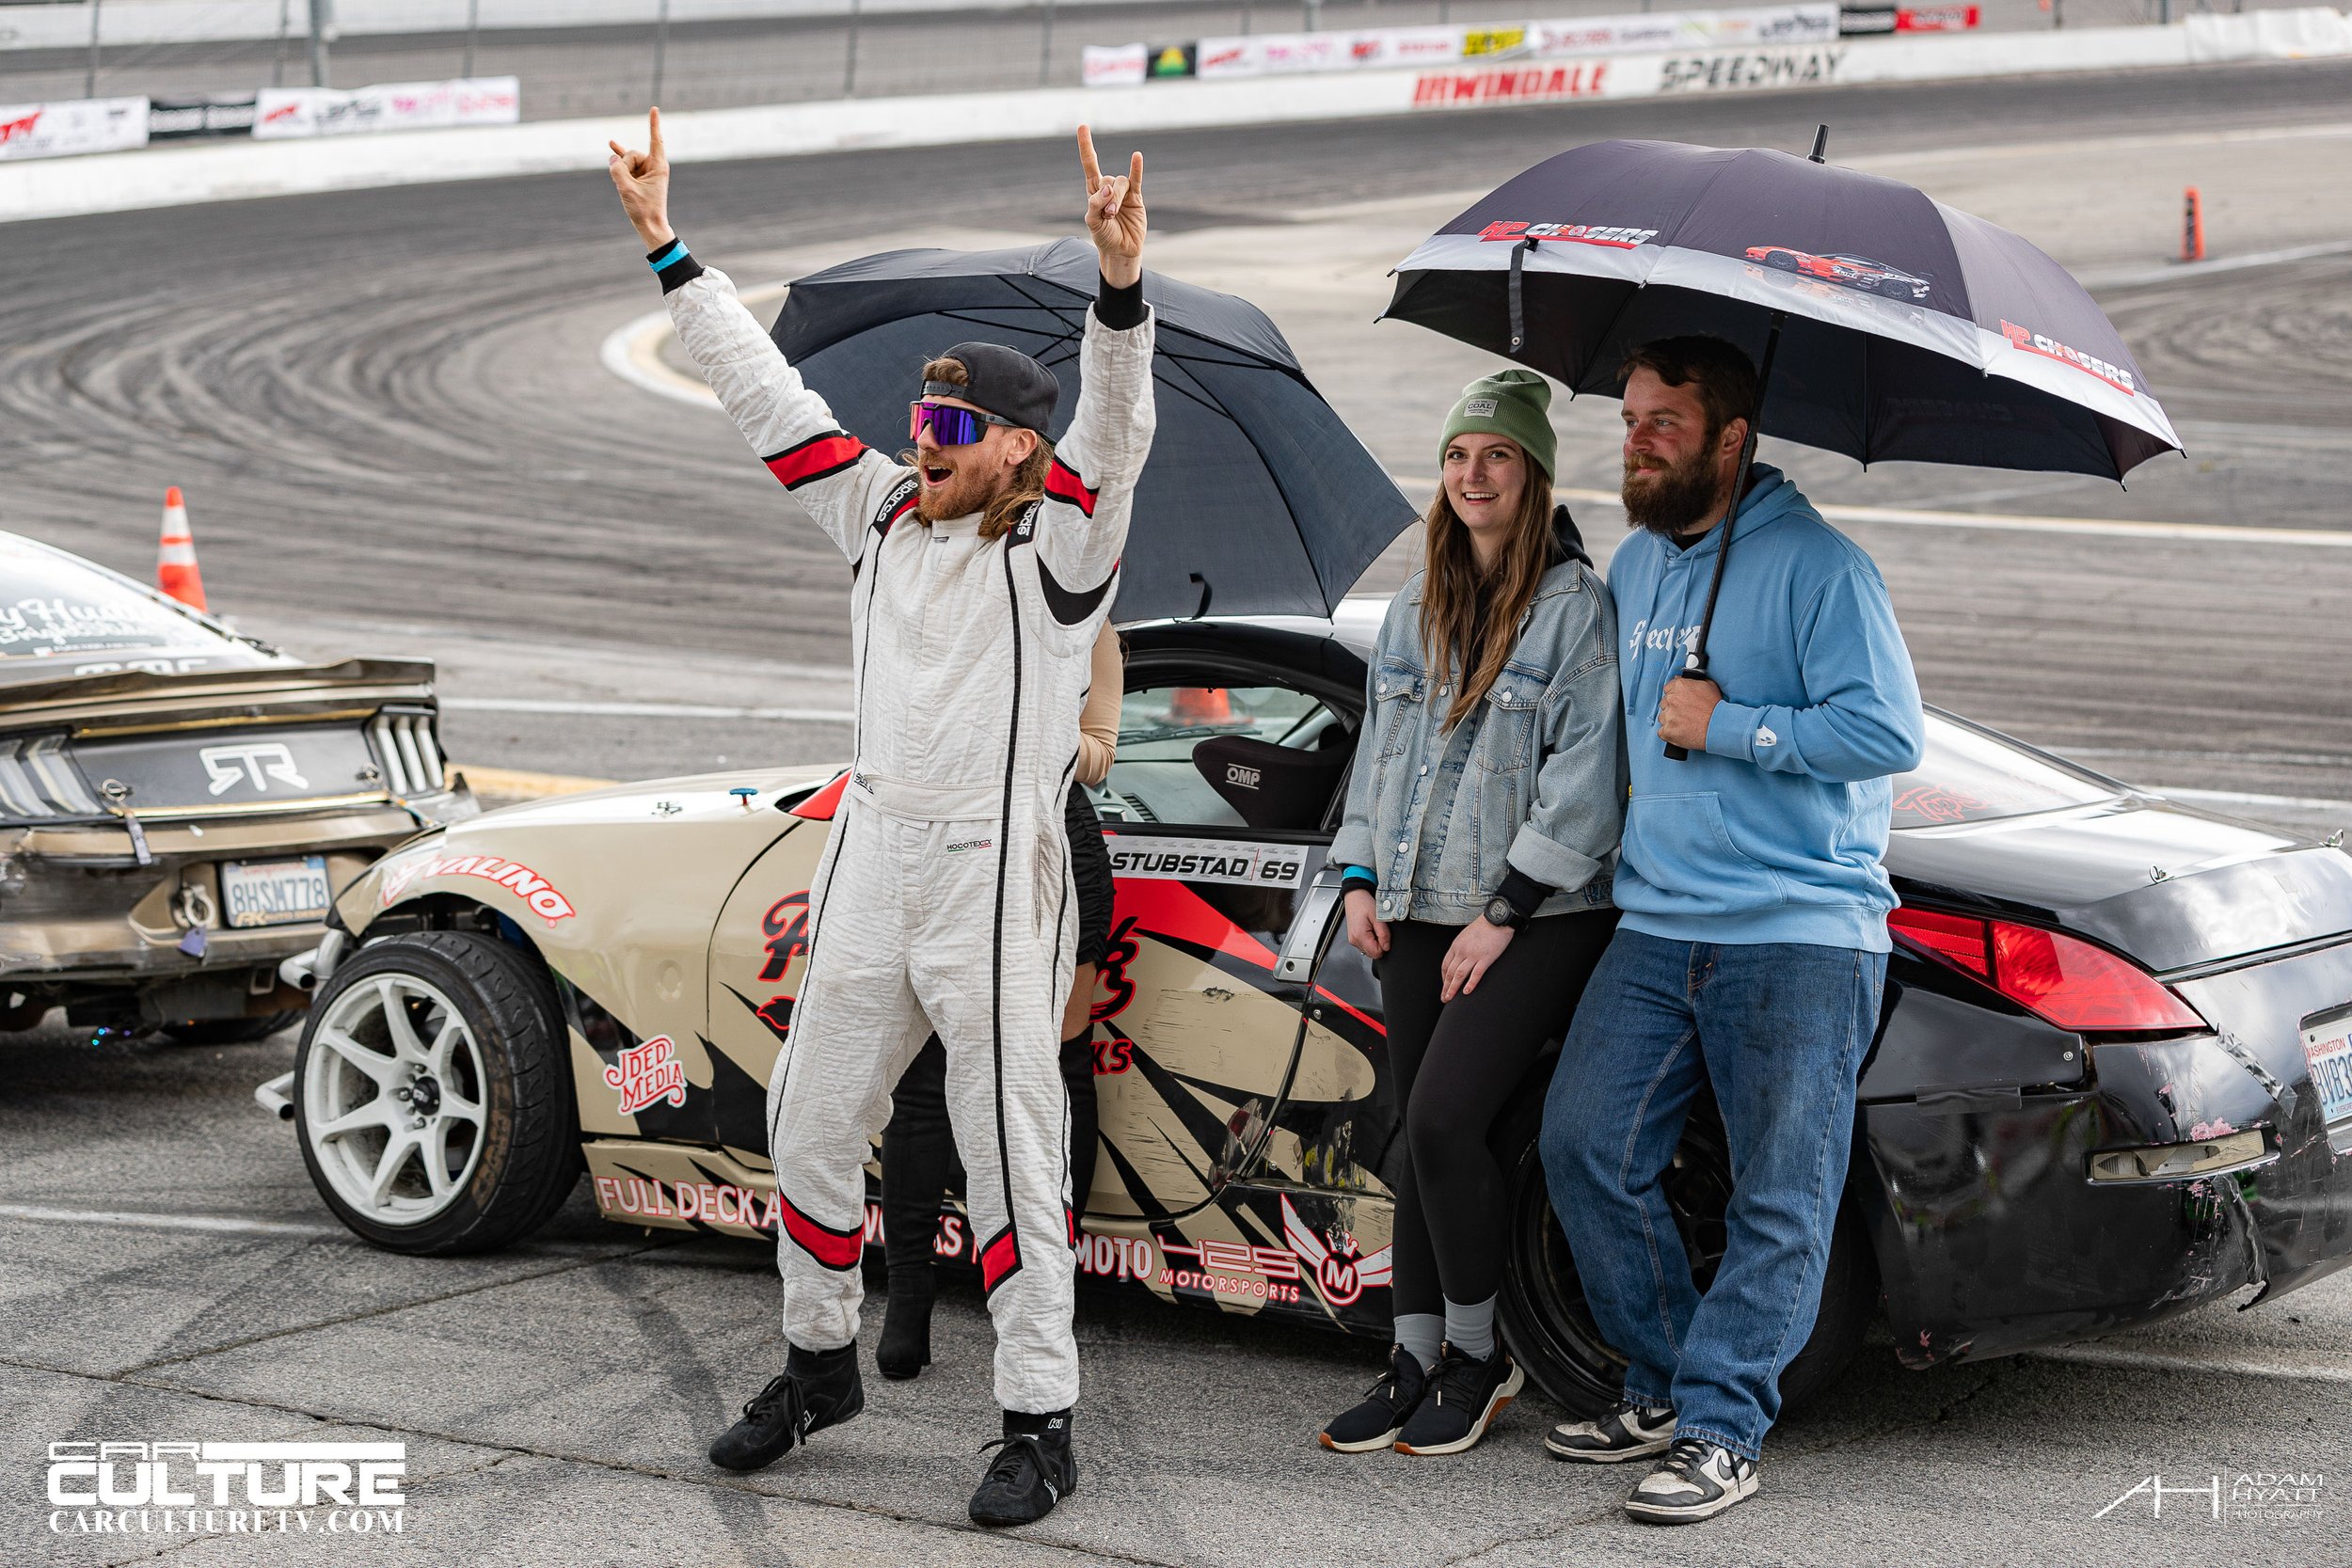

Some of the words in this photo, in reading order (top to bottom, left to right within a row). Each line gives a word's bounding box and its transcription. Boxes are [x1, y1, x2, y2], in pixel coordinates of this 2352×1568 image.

[1660, 45, 1844, 93] SPEEDWAY
[1477, 220, 1531, 238] HP
[1999, 318, 2031, 343] HP
[876, 479, 919, 523] sparco
[1016, 499, 1041, 536] sparc
[199, 743, 310, 797] RTR
[1227, 767, 1261, 786] OMP
[1110, 851, 1249, 877] STUBSTAD
[1260, 860, 1301, 881] 69
[423, 855, 577, 920] VALINO
[2306, 1037, 2346, 1061] WASHINGTON
[621, 1063, 684, 1113] MEDIA
[596, 1177, 673, 1217] FULL
[675, 1180, 759, 1227] DECK
[1075, 1233, 1154, 1280] MOTO
[1158, 1268, 1301, 1304] MOTORSPORTS
[1325, 1259, 1353, 1294] M
